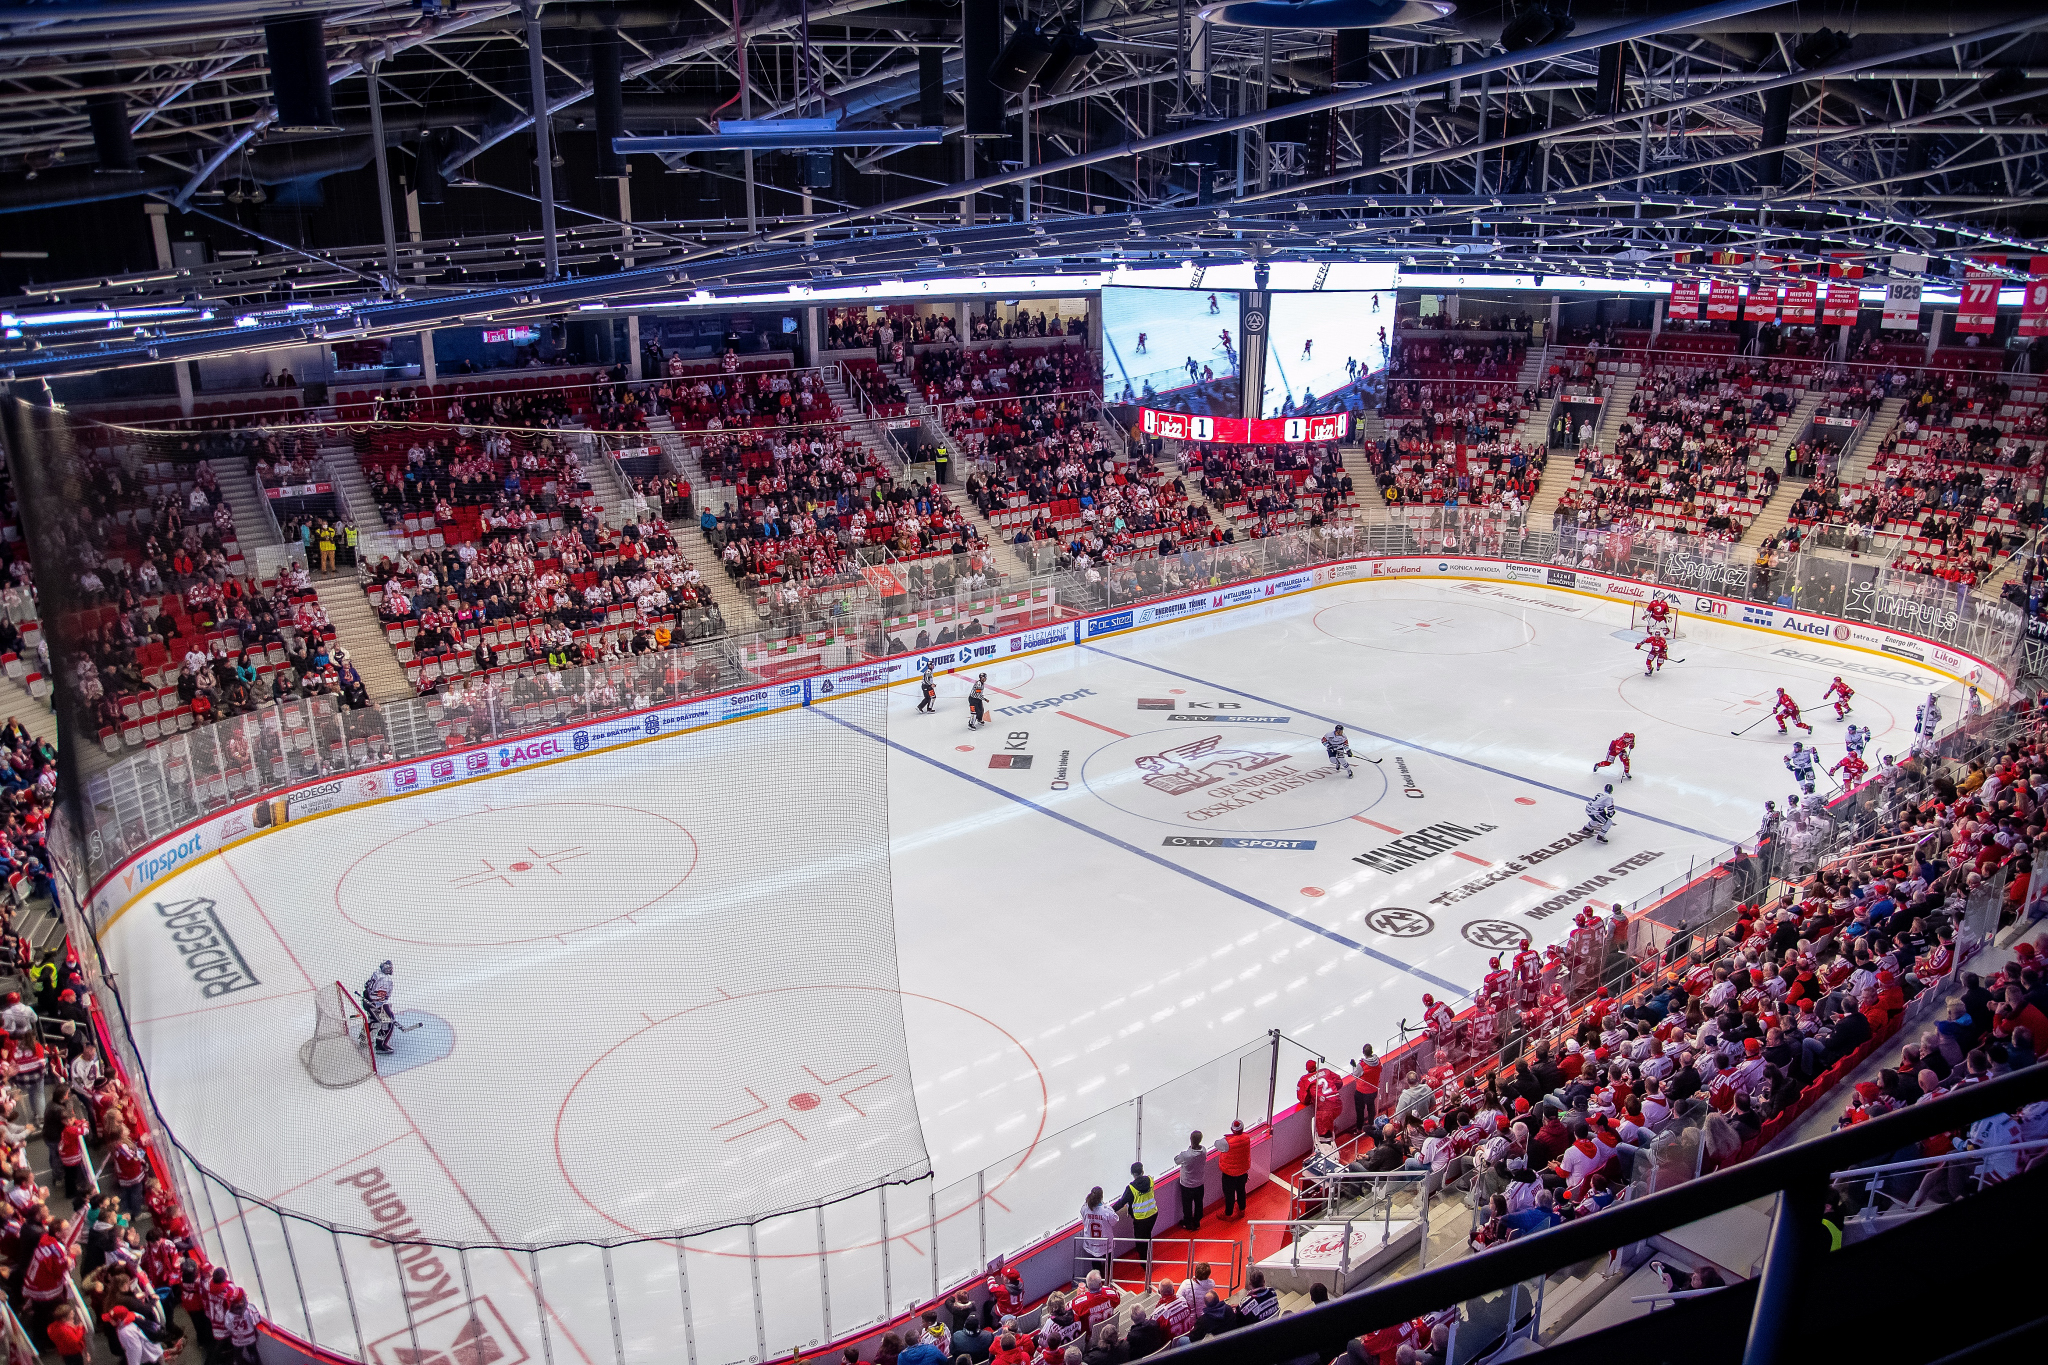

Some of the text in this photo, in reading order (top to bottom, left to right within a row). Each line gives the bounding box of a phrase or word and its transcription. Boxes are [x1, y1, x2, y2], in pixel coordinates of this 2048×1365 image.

[1888, 284, 1922, 300] 1929
[1968, 284, 1993, 303] 77
[1198, 419, 1206, 437] 1
[1292, 421, 1299, 438] 1
[1386, 565, 1421, 574] Kaufland
[1506, 563, 1542, 574] Hemorex
[1605, 582, 1645, 598] Realistic
[1652, 589, 1682, 605] KMA
[1875, 594, 1959, 631] IMPULS
[1783, 616, 1830, 637] Autel
[1853, 631, 1879, 644] tatra.cz
[1885, 635, 1906, 647] Energo
[1770, 647, 1949, 687] RADEGAST
[1934, 650, 1959, 667] Likop
[731, 691, 768, 706] Sencito
[994, 688, 1098, 717] Tipsport
[1188, 701, 1242, 710] KB
[1004, 731, 1029, 751] KB
[512, 739, 565, 763] AGEL
[1207, 764, 1302, 799] GENERALI
[288, 780, 344, 805] RADEGAST
[1182, 791, 1254, 822] ČESKÁ
[1237, 839, 1302, 848] SPORT
[136, 833, 202, 884] Tipsport
[1524, 848, 1666, 921] MORAVIA STEEL
[153, 896, 261, 999] RADEGAST
[1317, 1077, 1333, 1095] 2
[335, 1166, 461, 1312] Kaufland
[1090, 1222, 1102, 1238] 6
